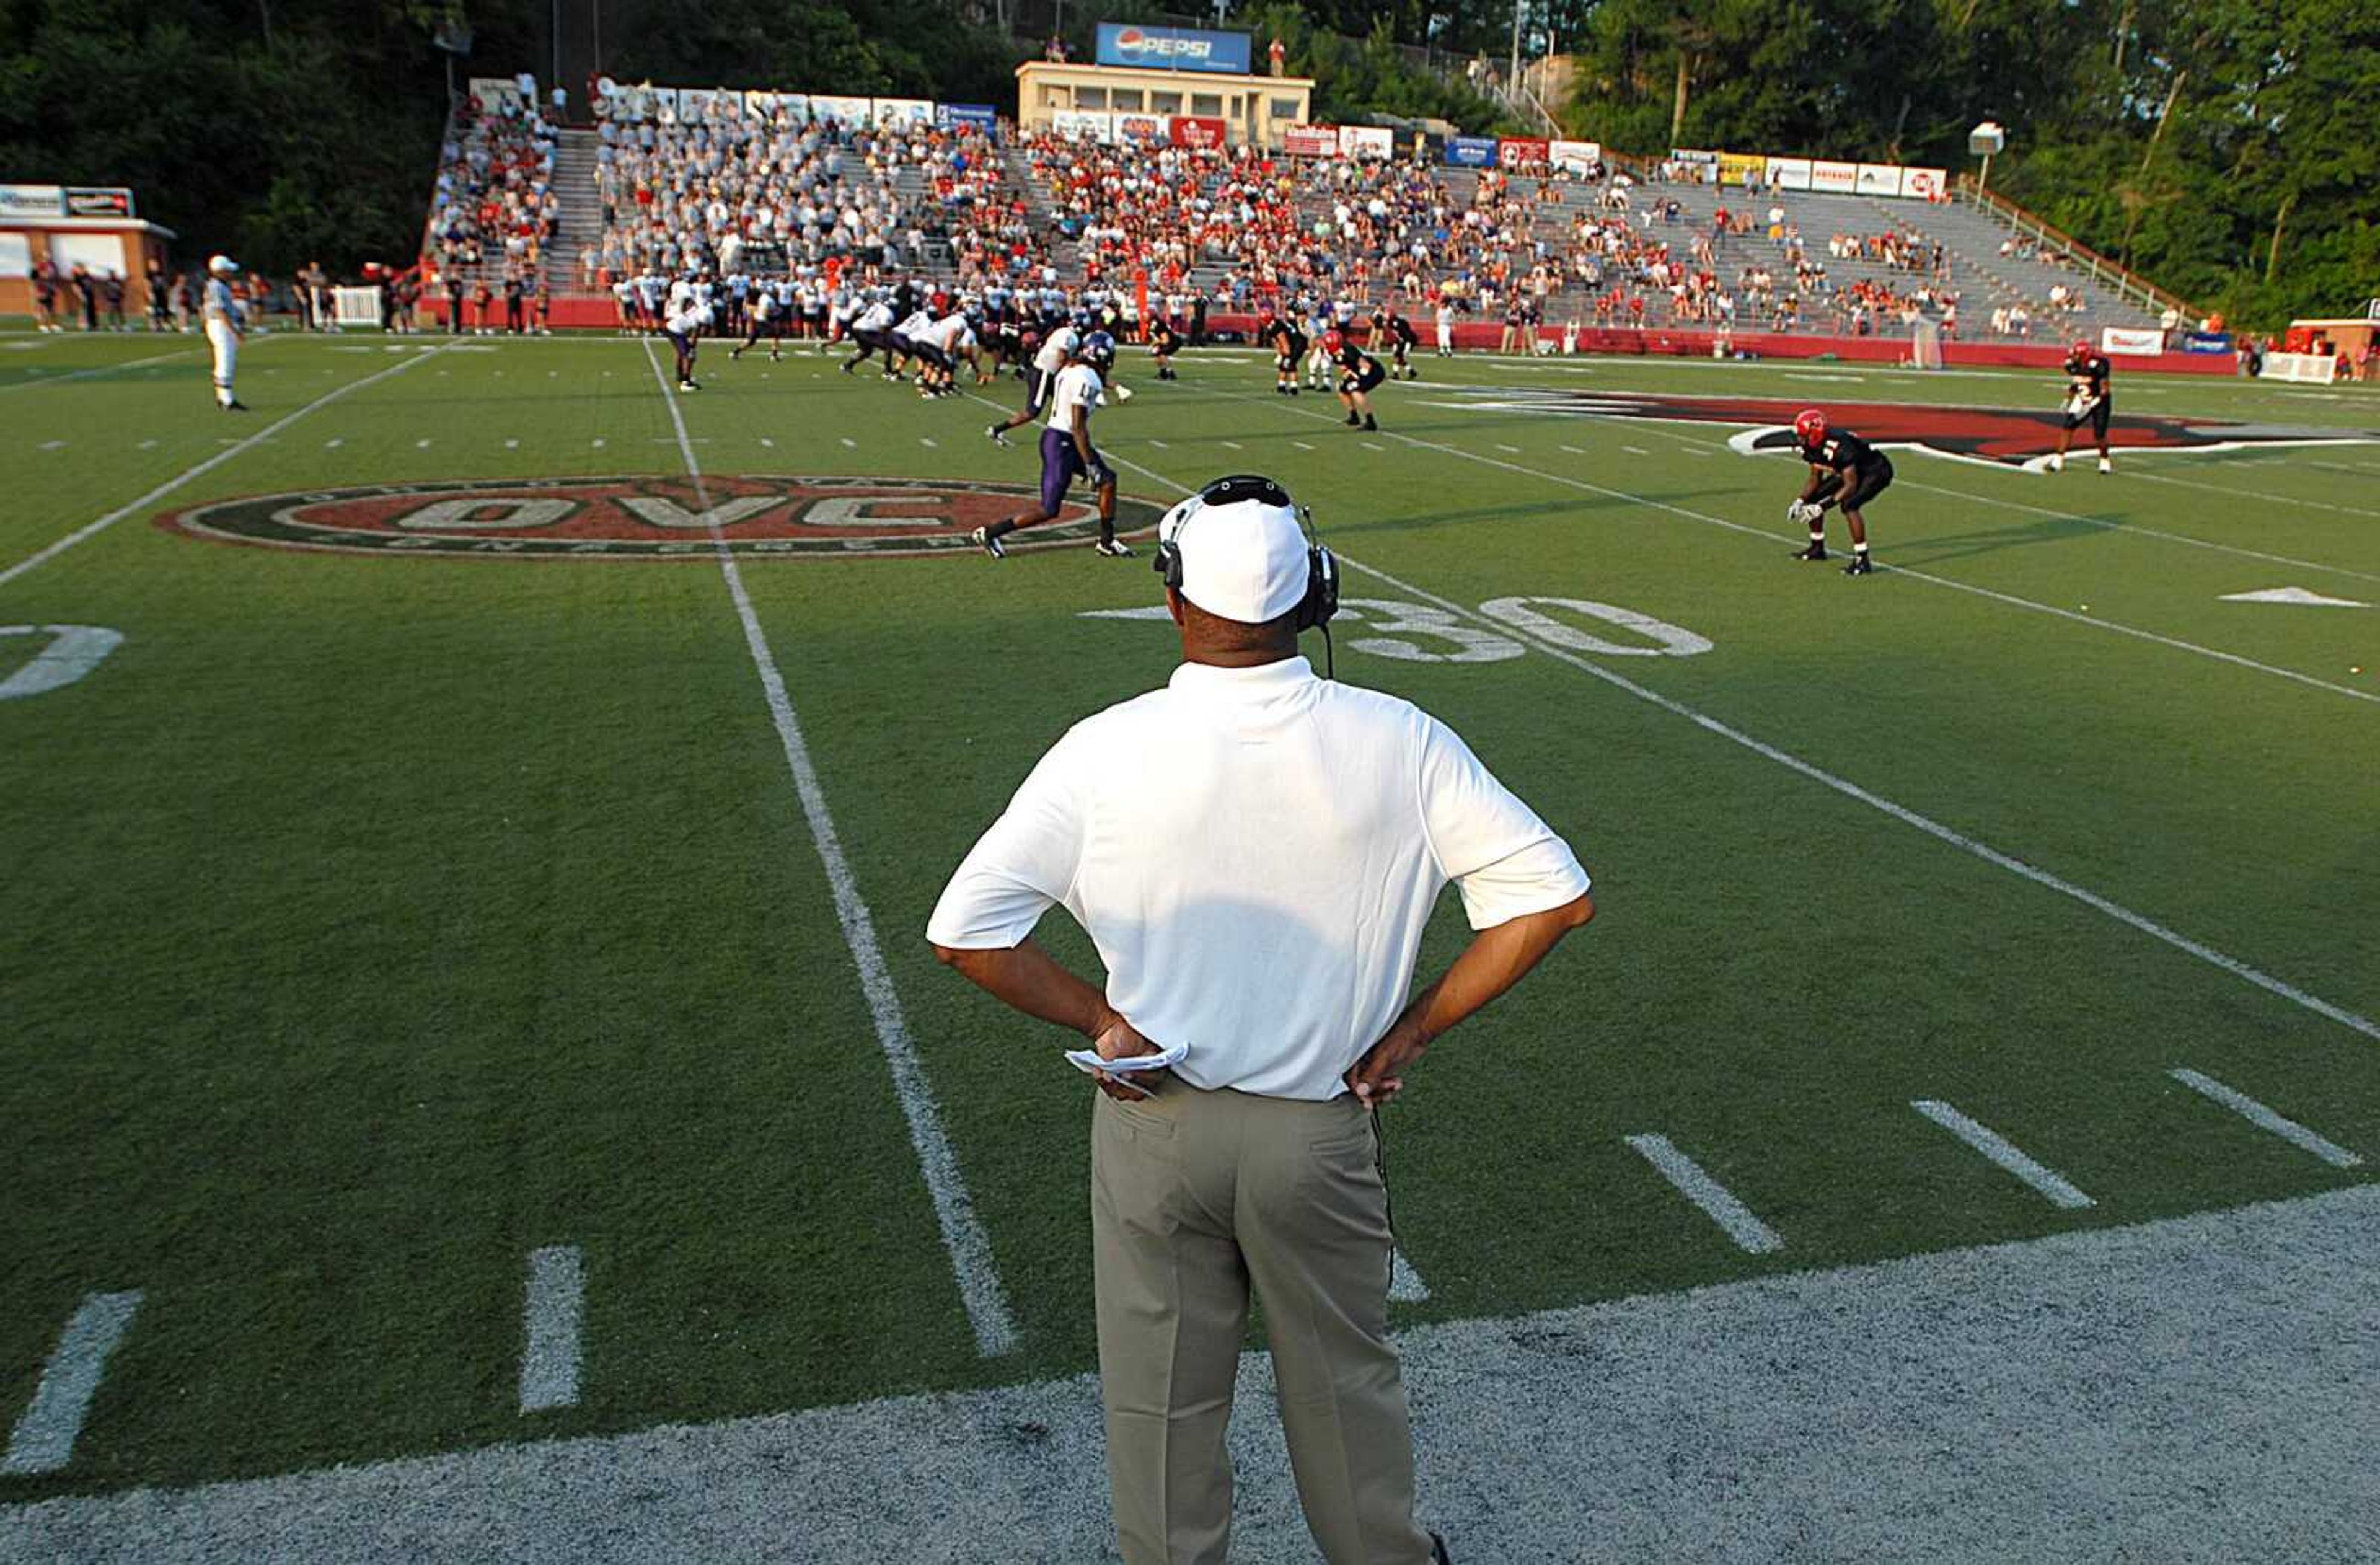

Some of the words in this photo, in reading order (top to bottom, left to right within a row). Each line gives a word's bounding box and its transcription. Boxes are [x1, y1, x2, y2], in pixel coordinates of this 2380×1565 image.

[1143, 37, 1212, 58] PEPSI
[395, 496, 943, 529] OVC
[1330, 596, 1714, 662] 30
